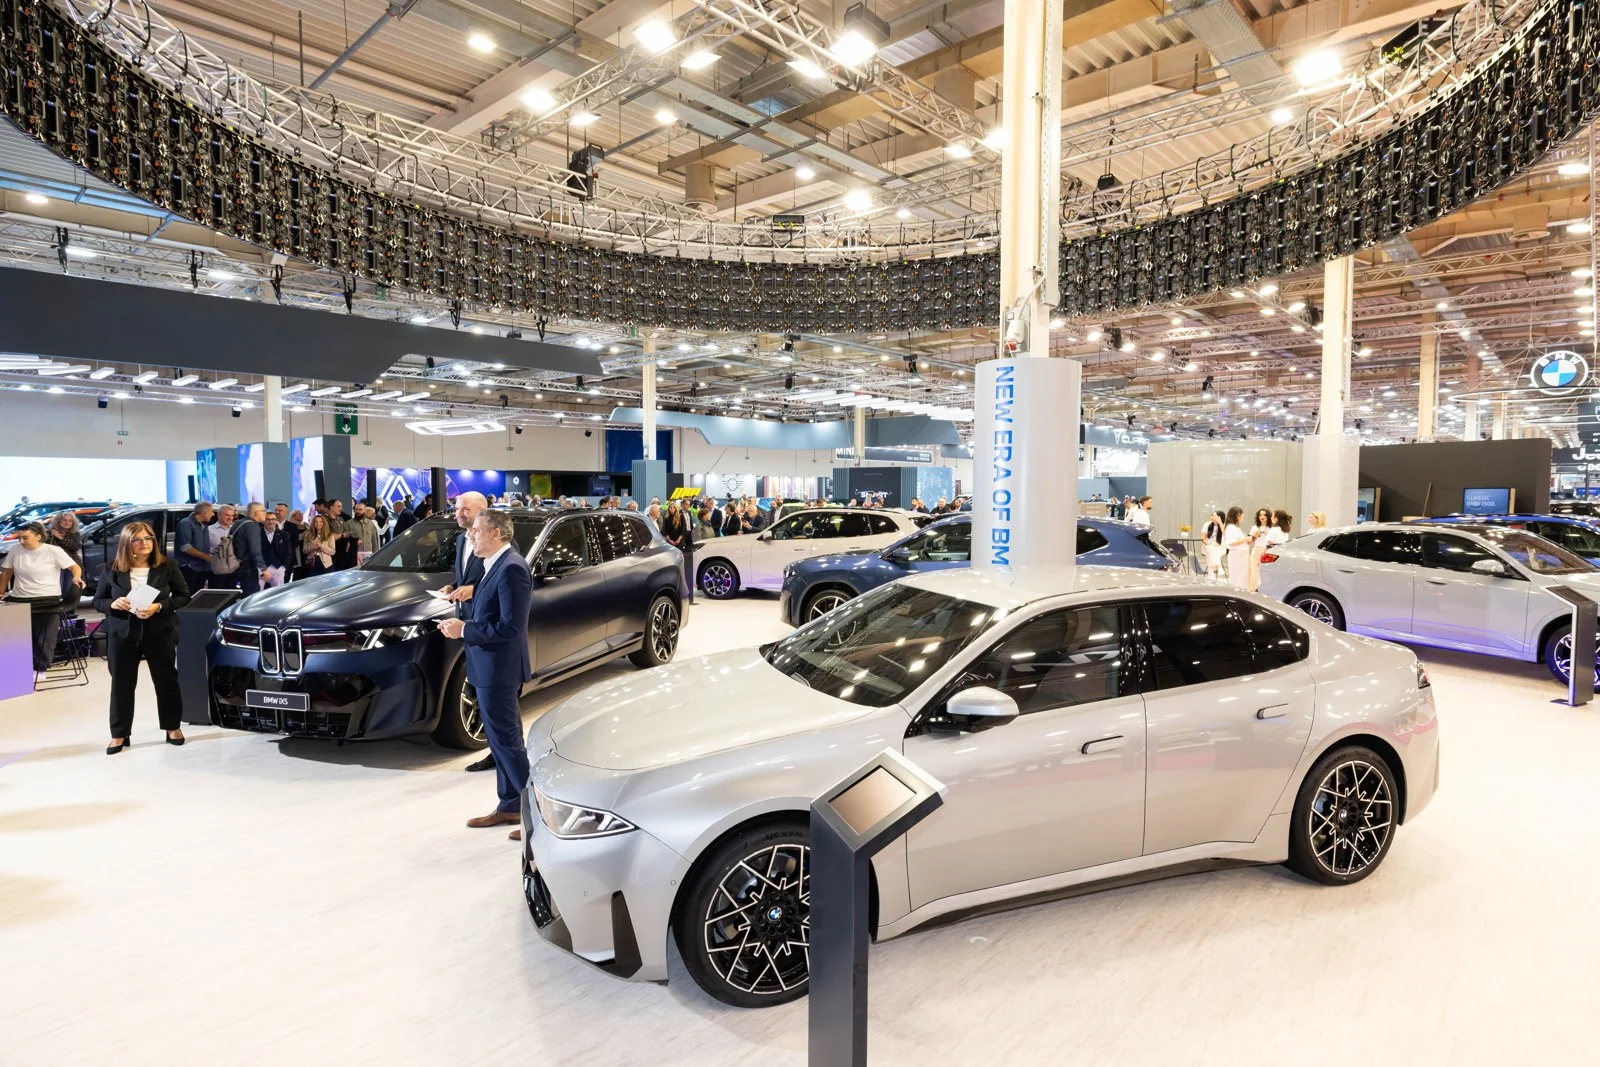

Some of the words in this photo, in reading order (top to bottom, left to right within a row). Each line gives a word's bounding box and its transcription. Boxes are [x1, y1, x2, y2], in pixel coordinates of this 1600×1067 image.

[995, 366, 1014, 423] NEW
[835, 447, 854, 456] MINI
[1121, 435, 1150, 446] CUPRA
[993, 430, 1013, 482] ERA
[992, 488, 1012, 522] OF
[991, 528, 1012, 567] BM
[263, 696, 278, 704] BMW
[766, 831, 803, 839] NEXEN
